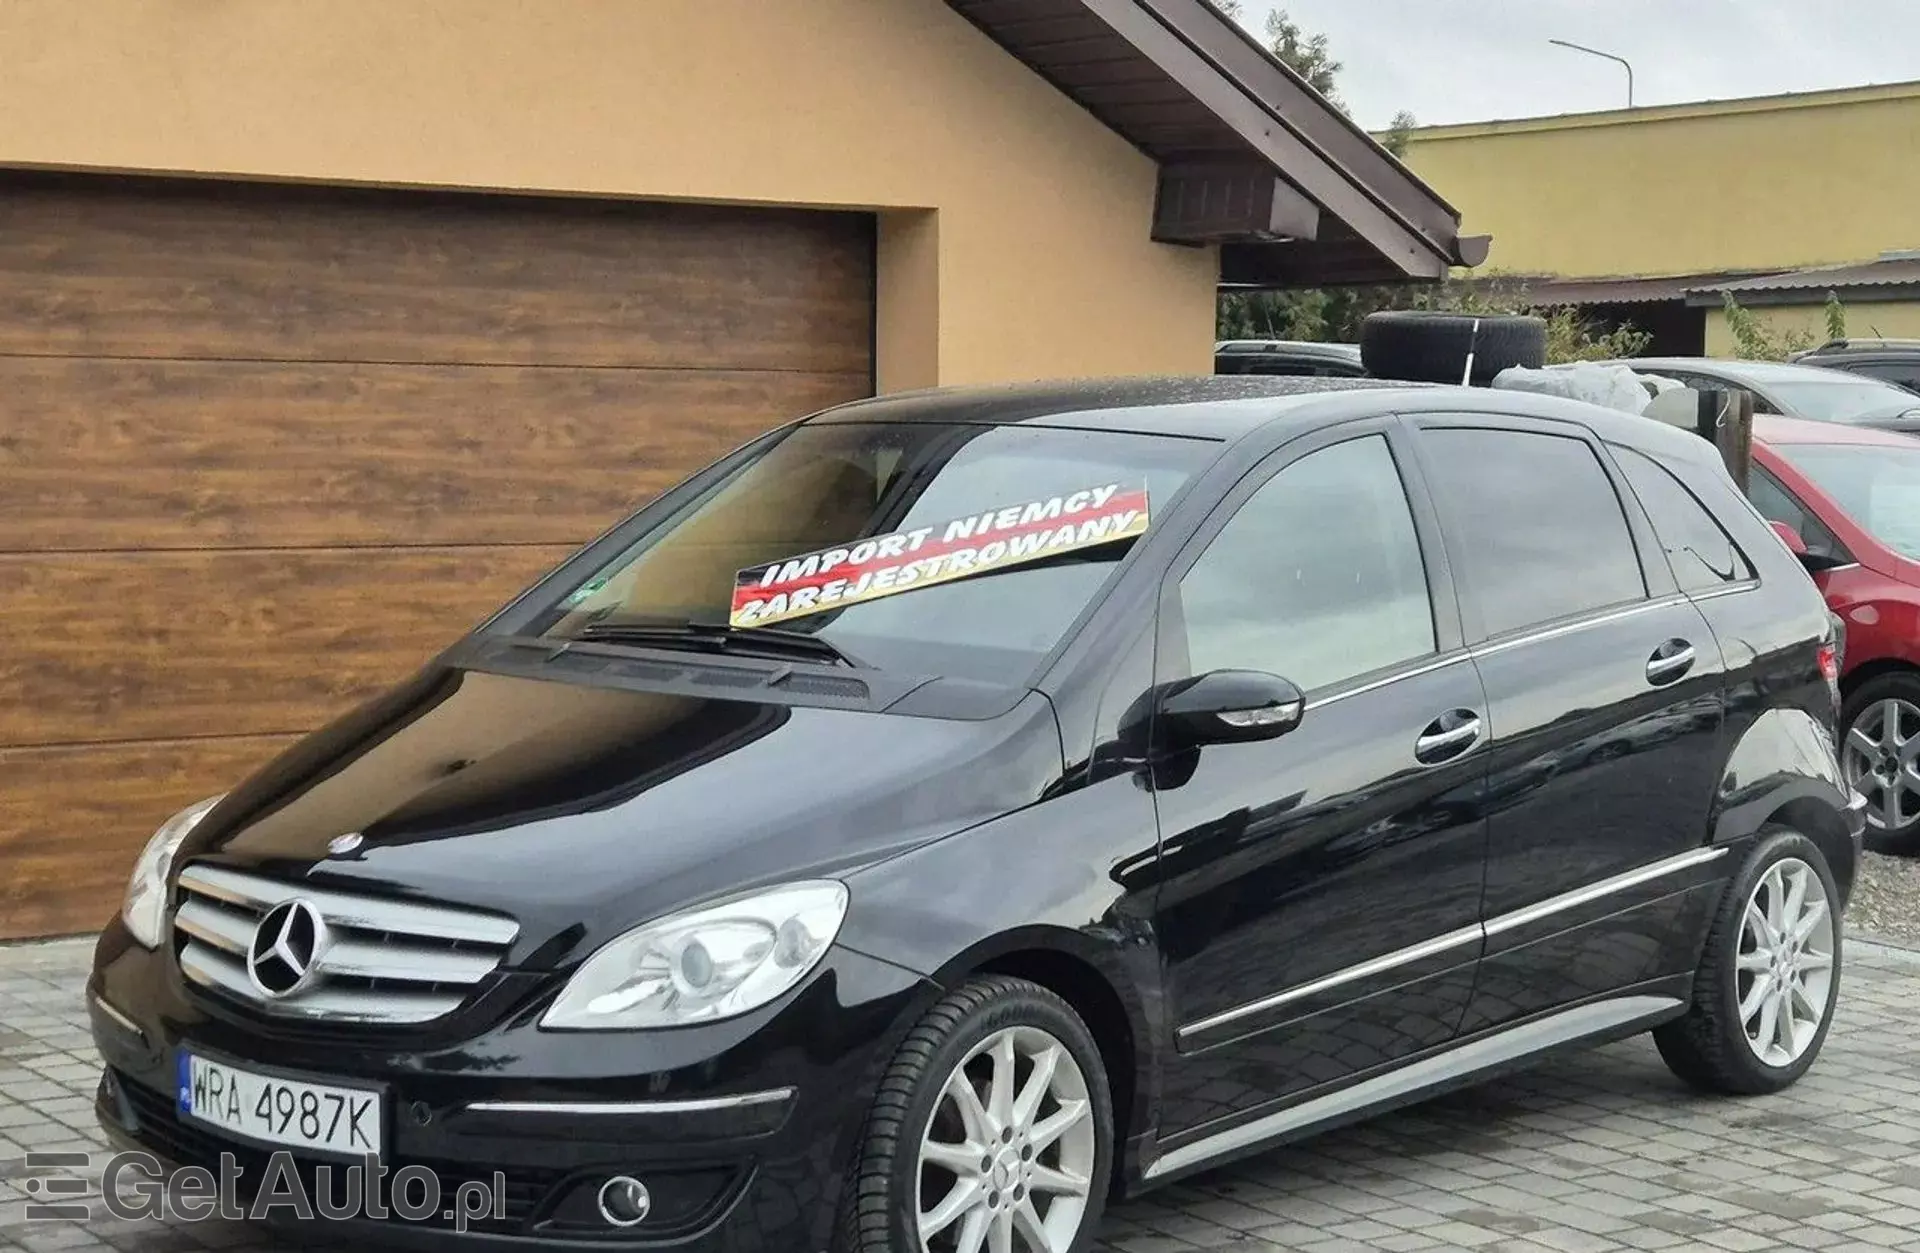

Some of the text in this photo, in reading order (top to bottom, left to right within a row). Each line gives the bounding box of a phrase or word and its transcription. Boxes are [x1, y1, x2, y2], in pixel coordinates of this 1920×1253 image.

[738, 509, 1140, 622] ZAREJESTROWANY
[760, 484, 1118, 589] IMPORT NIEMCY
[193, 1061, 374, 1149] WRA 4987K
